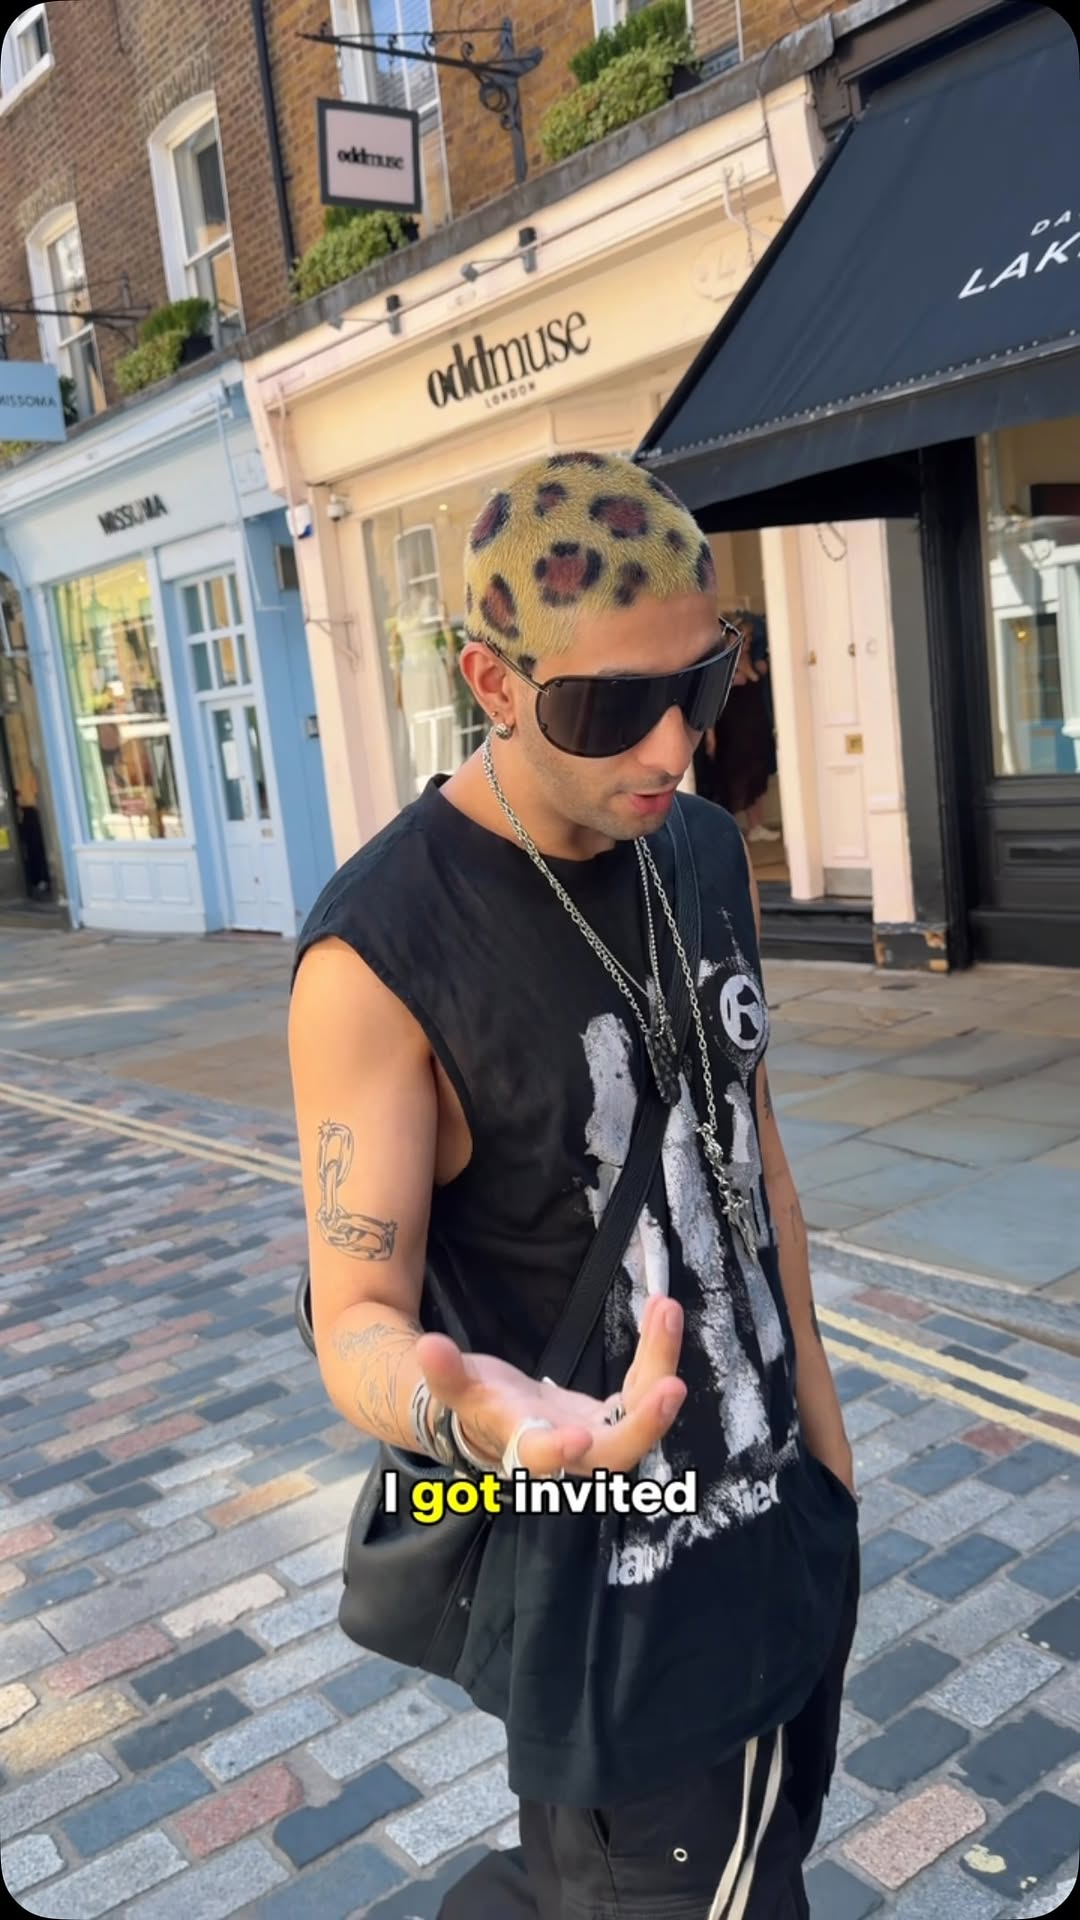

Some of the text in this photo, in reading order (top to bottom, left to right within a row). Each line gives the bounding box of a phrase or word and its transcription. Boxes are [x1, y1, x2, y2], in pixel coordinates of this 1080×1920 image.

[337, 146, 404, 170] oddmuse
[1030, 209, 1080, 236] DA
[958, 231, 1080, 299] LAK
[427, 311, 591, 408] oddmuse
[484, 381, 536, 408] LONDON
